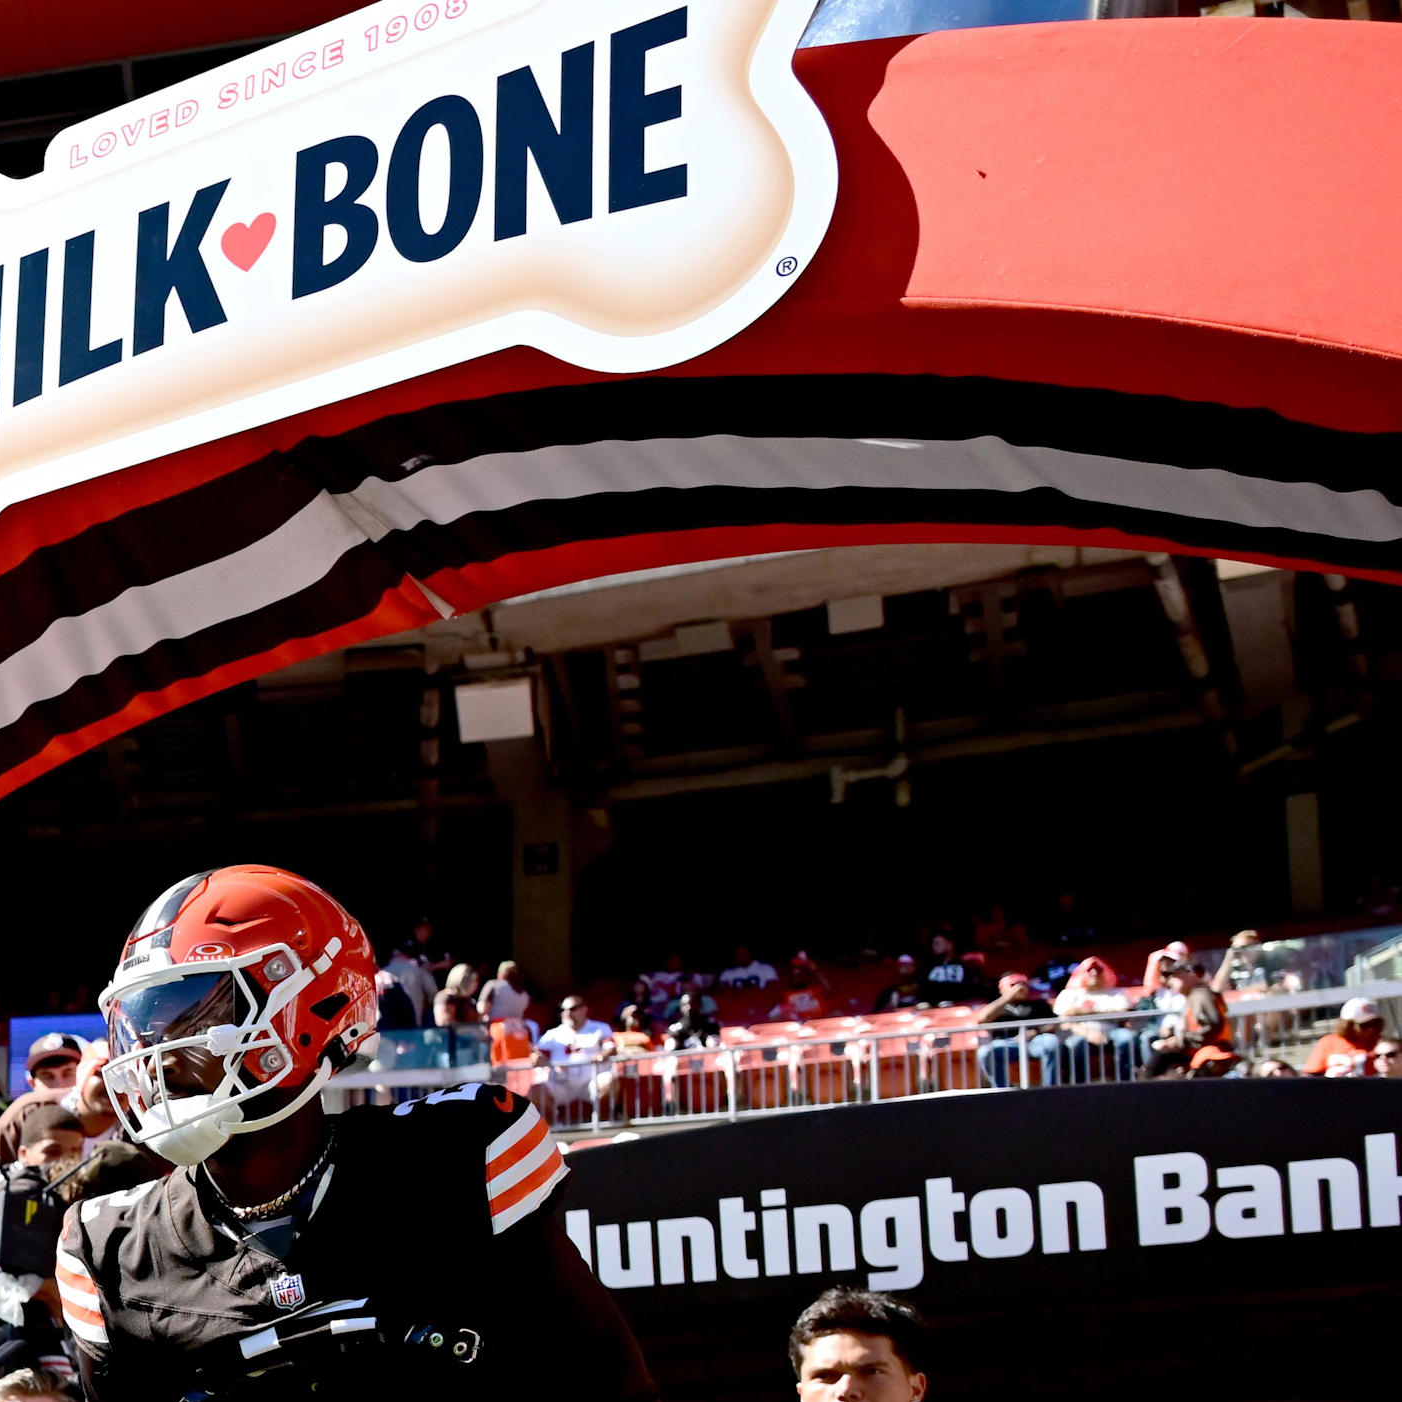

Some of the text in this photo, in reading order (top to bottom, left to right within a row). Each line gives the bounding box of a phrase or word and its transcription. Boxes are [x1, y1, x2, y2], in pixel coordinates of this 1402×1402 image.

[68, 0, 469, 169] LOVED SINCE 1908
[291, 5, 688, 300] BONE
[278, 1288, 300, 1305] NFL
